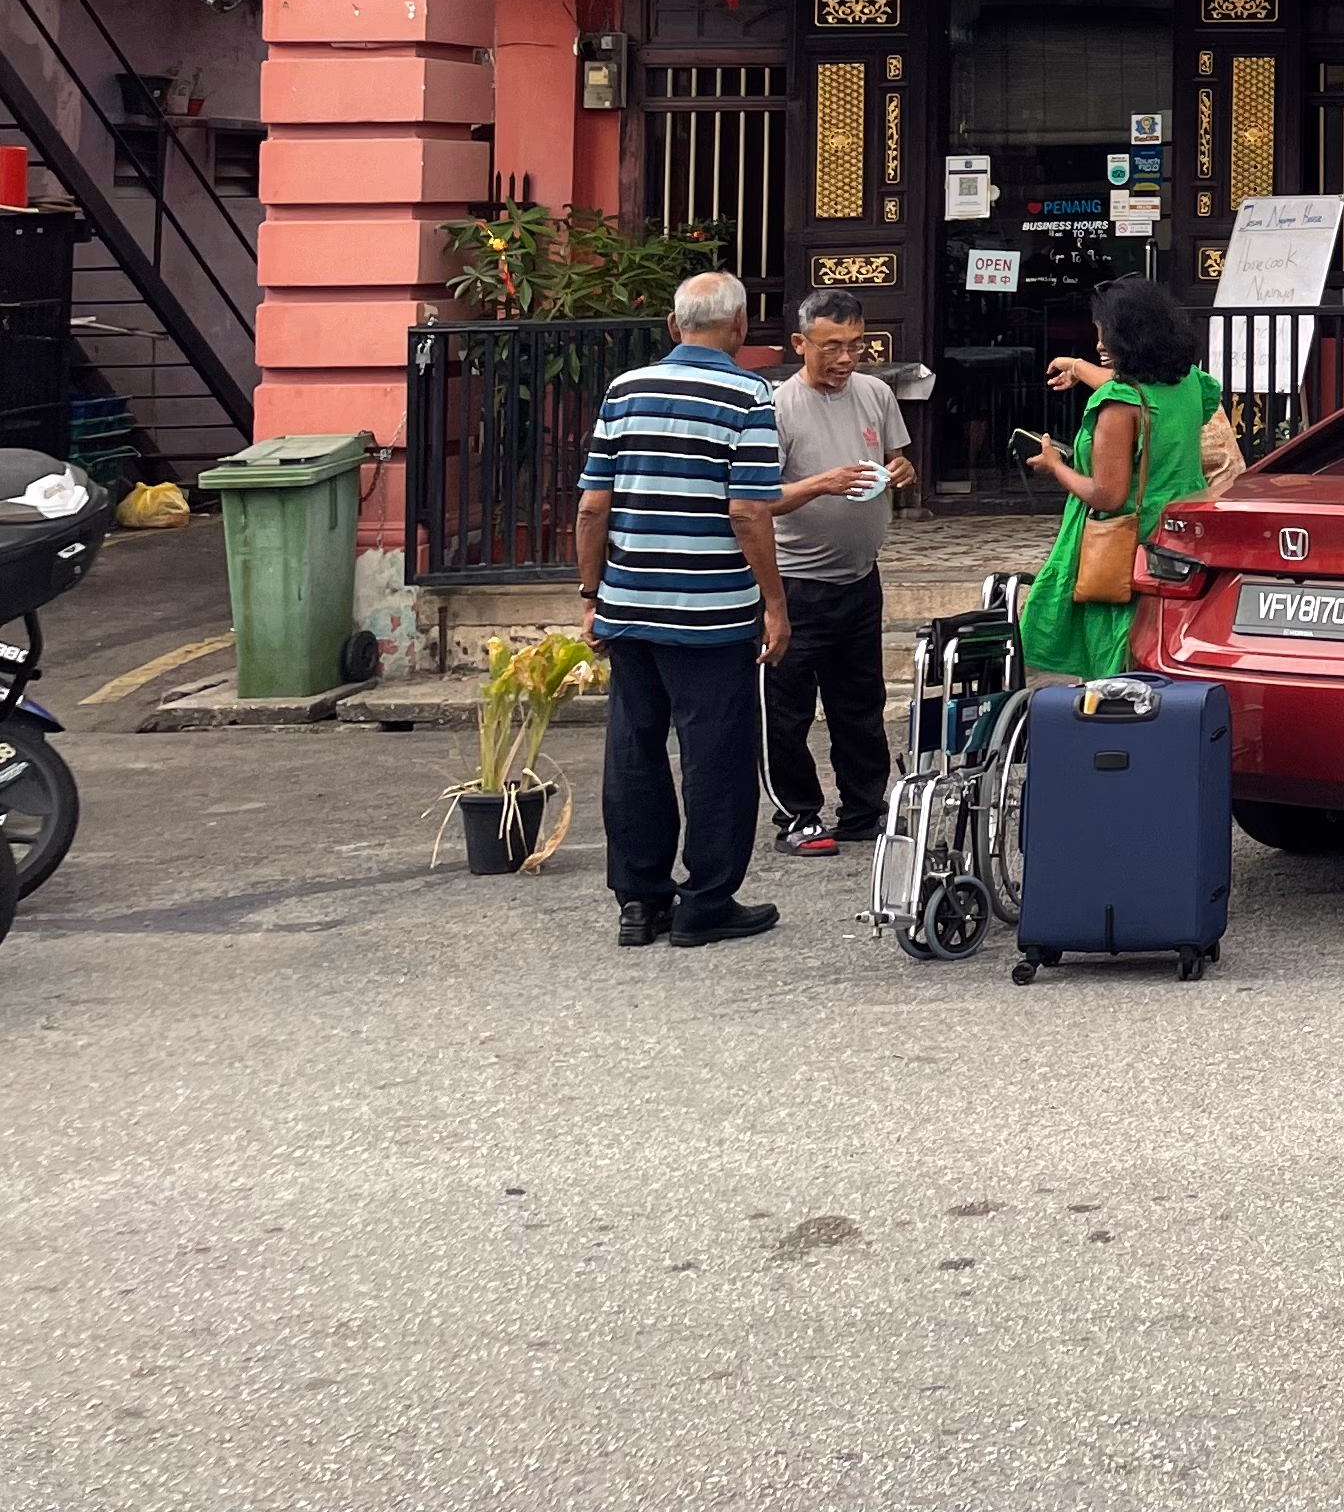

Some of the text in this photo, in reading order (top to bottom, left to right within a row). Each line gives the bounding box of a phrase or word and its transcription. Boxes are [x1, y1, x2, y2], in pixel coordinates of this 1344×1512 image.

[1043, 199, 1102, 215] PENANG
[1022, 220, 1109, 231] BUSINESS HOURS
[975, 257, 1013, 272] OPEN
